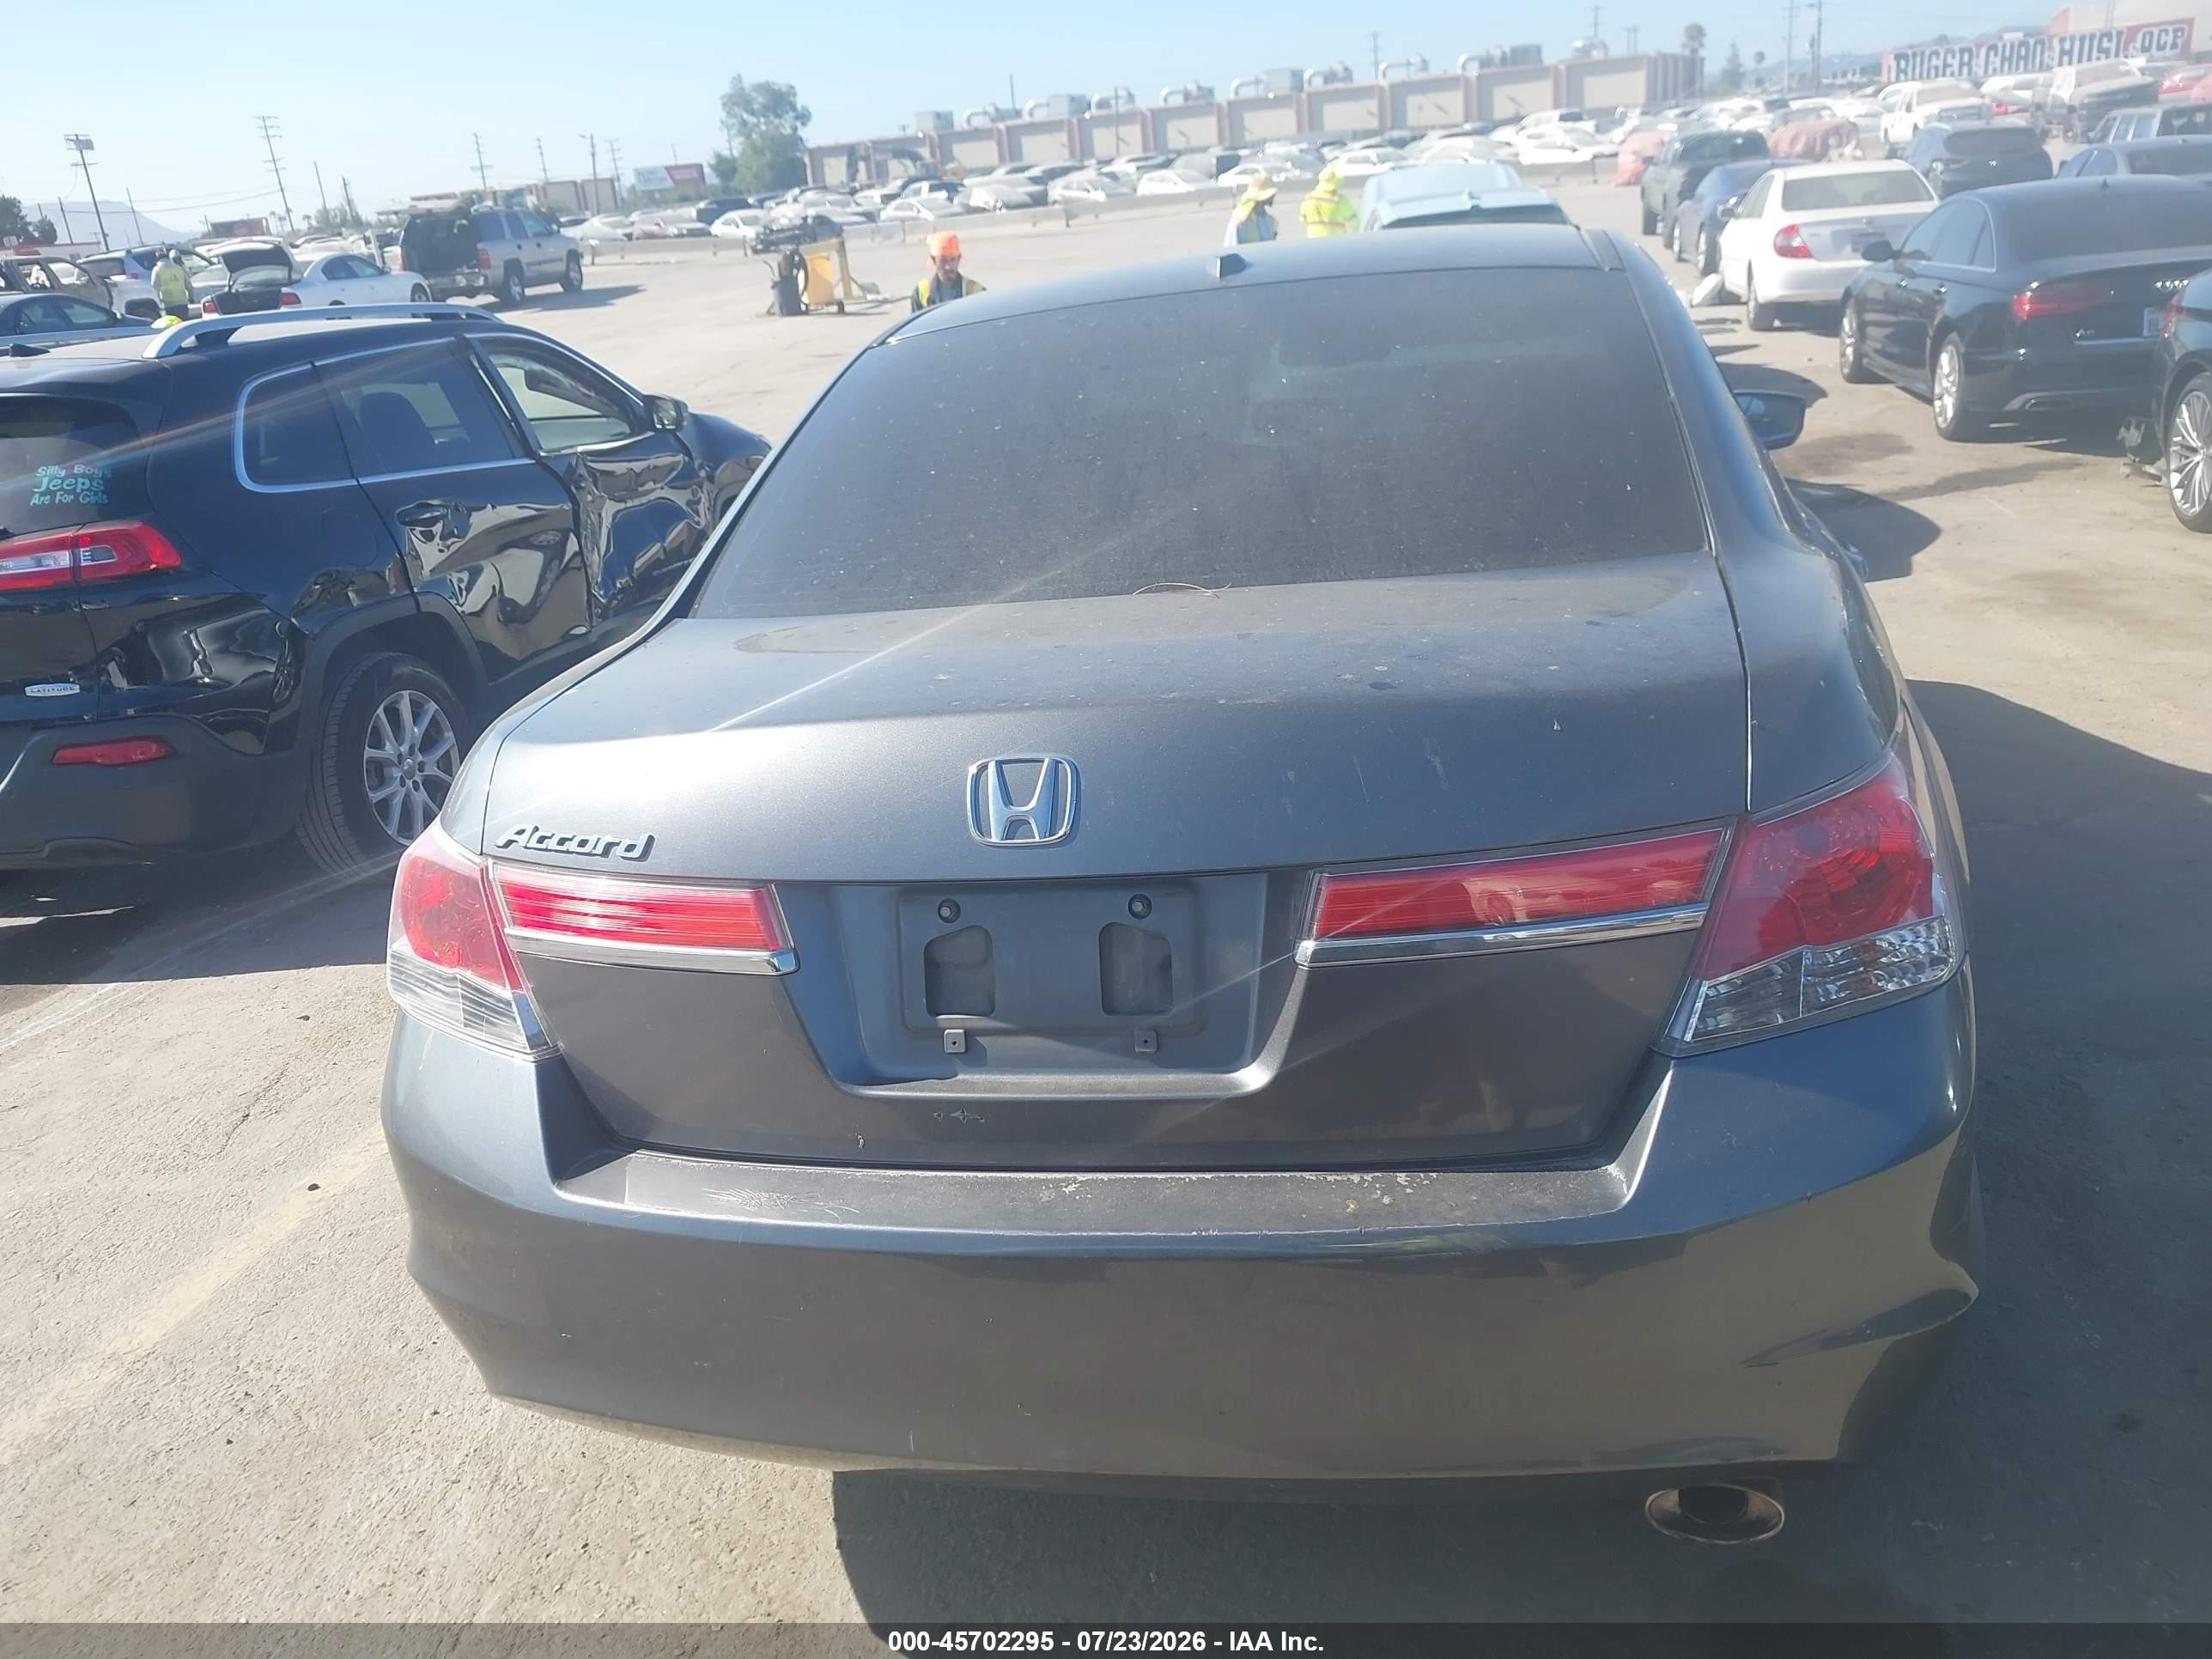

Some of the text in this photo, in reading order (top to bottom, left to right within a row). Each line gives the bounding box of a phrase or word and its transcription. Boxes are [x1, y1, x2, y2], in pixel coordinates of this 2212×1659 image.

[36, 465, 66, 477] Silly
[33, 477, 105, 493] Jeeps
[30, 490, 109, 506] Are For Girls
[494, 823, 657, 863] Accord
